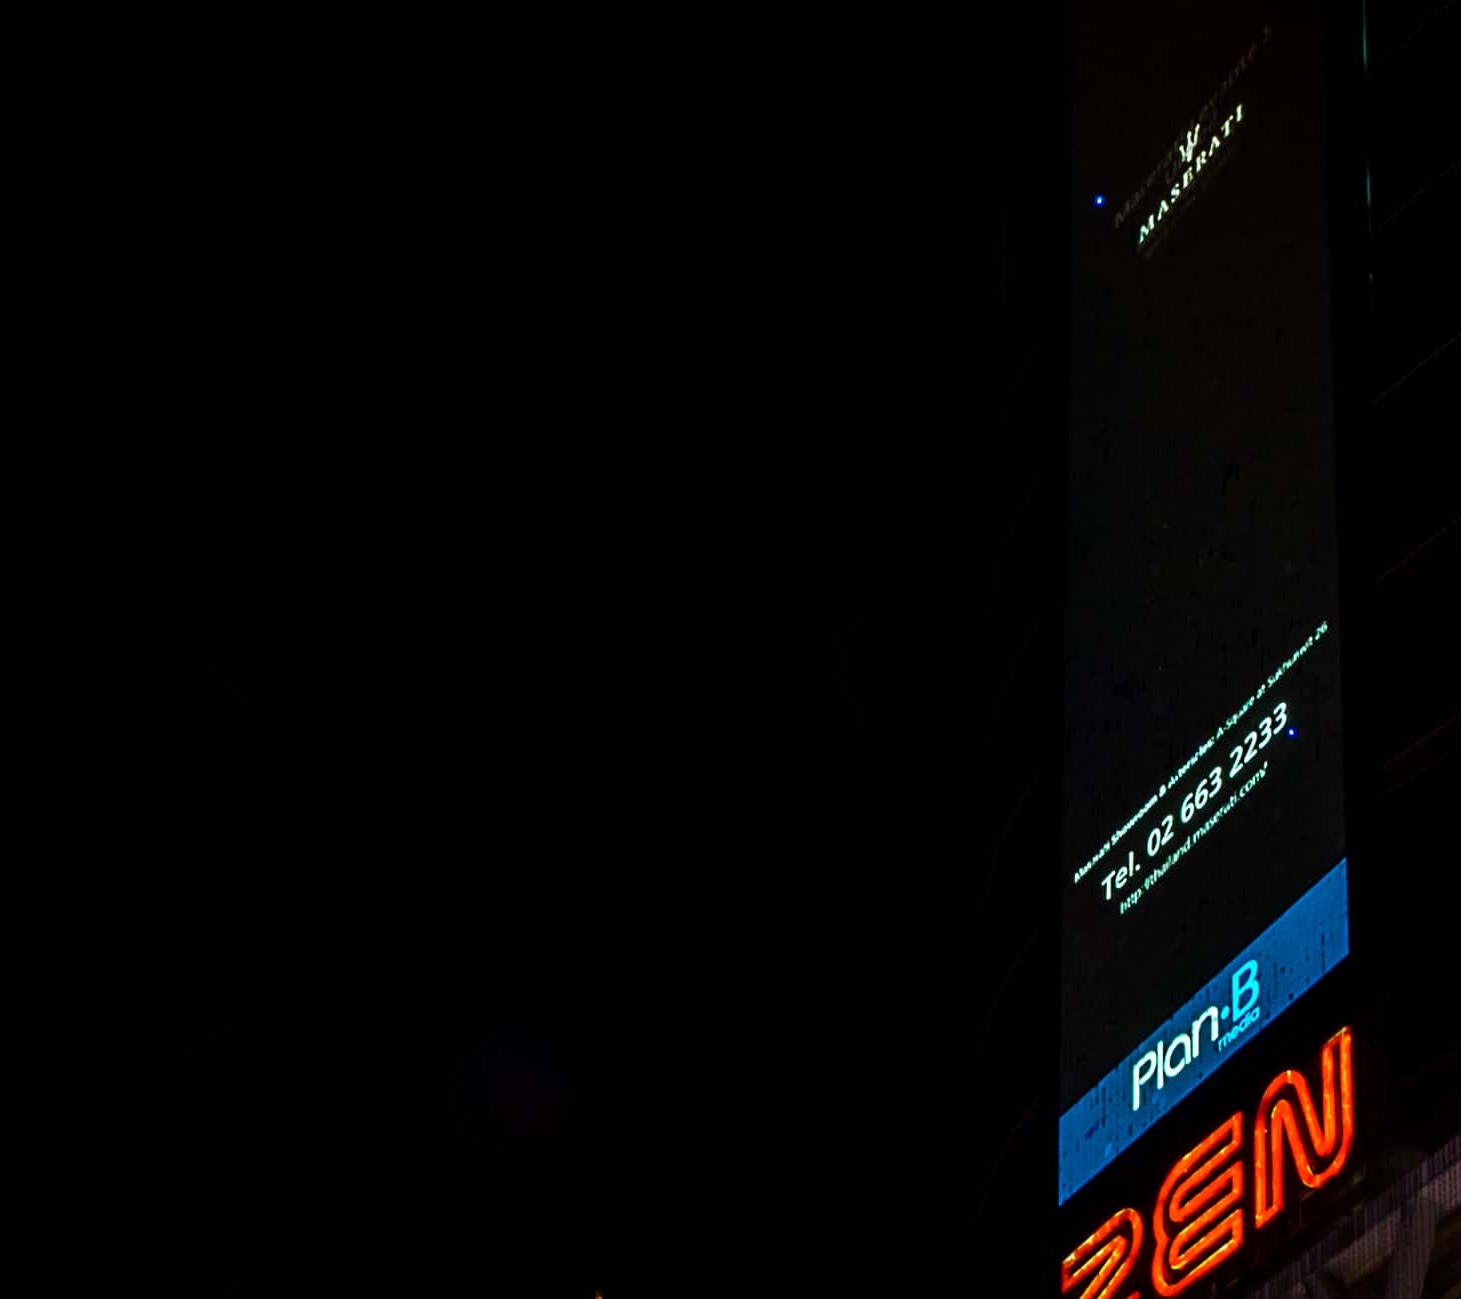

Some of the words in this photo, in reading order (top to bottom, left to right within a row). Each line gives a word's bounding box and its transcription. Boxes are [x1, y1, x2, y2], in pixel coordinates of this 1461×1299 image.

[1137, 101, 1245, 246] MASERATI
[1101, 851, 1141, 901] Tel.
[1147, 814, 1176, 857] 02
[1180, 765, 1223, 824] 663
[1229, 701, 1288, 778] 2233
[1218, 1006, 1261, 1053] media
